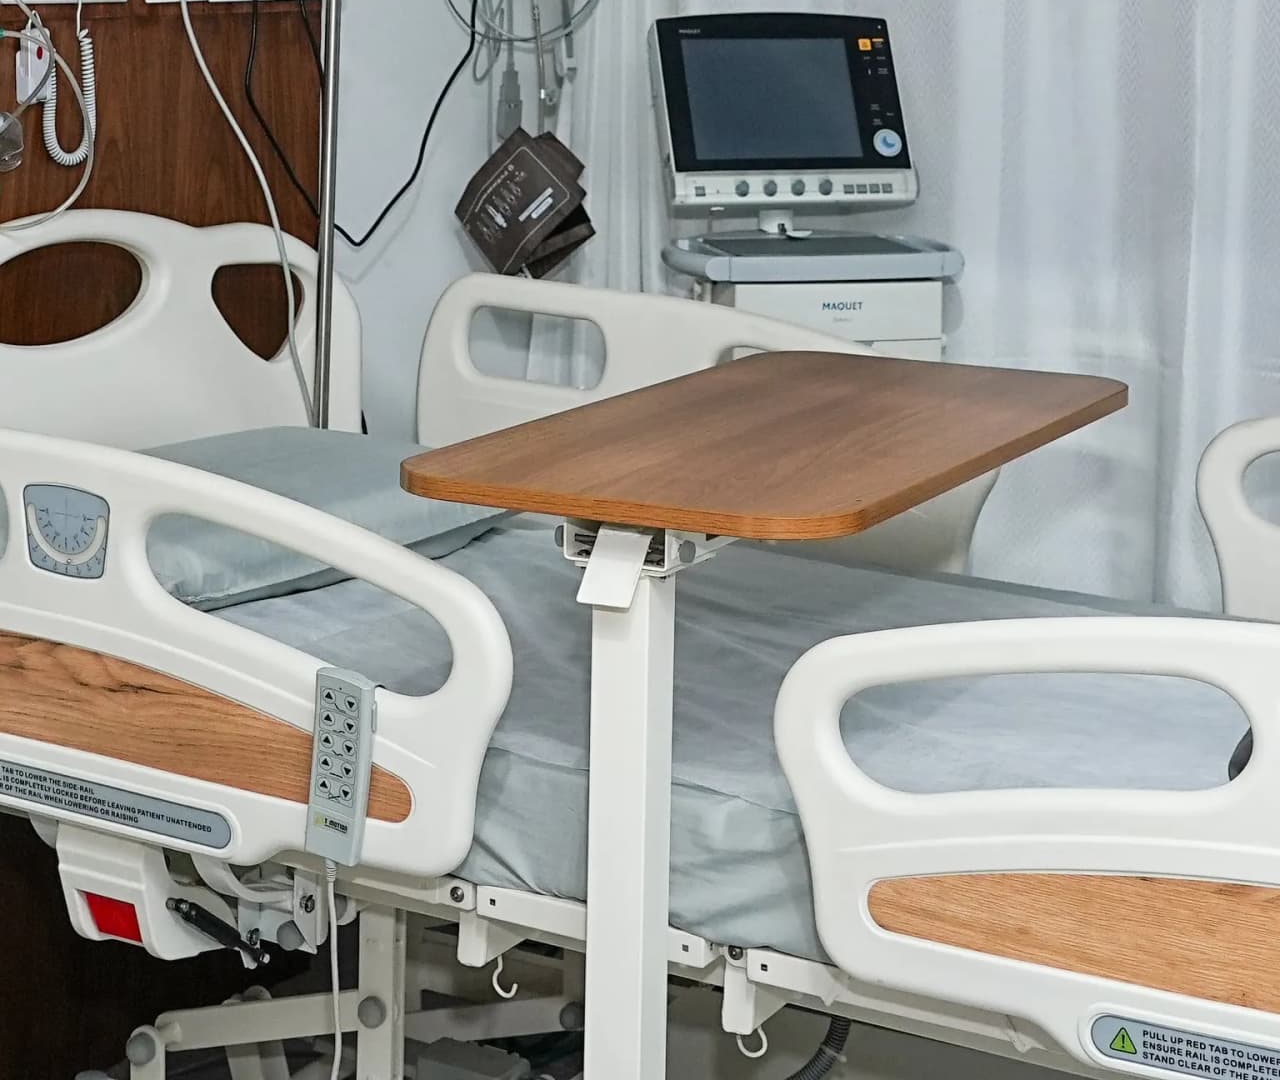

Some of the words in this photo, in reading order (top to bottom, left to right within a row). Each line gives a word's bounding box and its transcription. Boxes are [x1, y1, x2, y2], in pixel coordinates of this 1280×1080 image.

[822, 301, 864, 311] MAQUET
[2, 765, 14, 774] TAB
[15, 768, 24, 778] TO
[25, 770, 48, 782] LOWER
[49, 777, 61, 787] THE
[62, 779, 94, 795] SIDE-RAIL
[5, 784, 13, 792] OF
[14, 786, 27, 795] THE
[28, 789, 42, 800] RAIL
[44, 793, 64, 806] WHEN
[64, 800, 99, 814] LOWERING
[100, 808, 110, 817] OR
[111, 810, 139, 824] RAISING
[10, 776, 51, 792] COMPLETELY
[52, 785, 79, 799] LOCKED
[80, 794, 106, 807] BEFORE
[107, 801, 136, 814] LEAVING
[137, 808, 165, 821] PATIENT
[166, 816, 212, 833] UNATTENDED
[1142, 1029, 1168, 1042] PULL
[1170, 1035, 1183, 1045] UP
[1186, 1038, 1206, 1050] RED
[1208, 1044, 1228, 1055] TAB
[1231, 1049, 1244, 1058] TO
[1142, 1041, 1183, 1056] ENSURE
[1185, 1049, 1209, 1062] RAIL
[1211, 1055, 1220, 1064] IS
[1142, 1051, 1175, 1065] STAND
[1178, 1059, 1210, 1073] CLEAR
[1213, 1066, 1226, 1076] OF
[1229, 1070, 1249, 1080] THE
